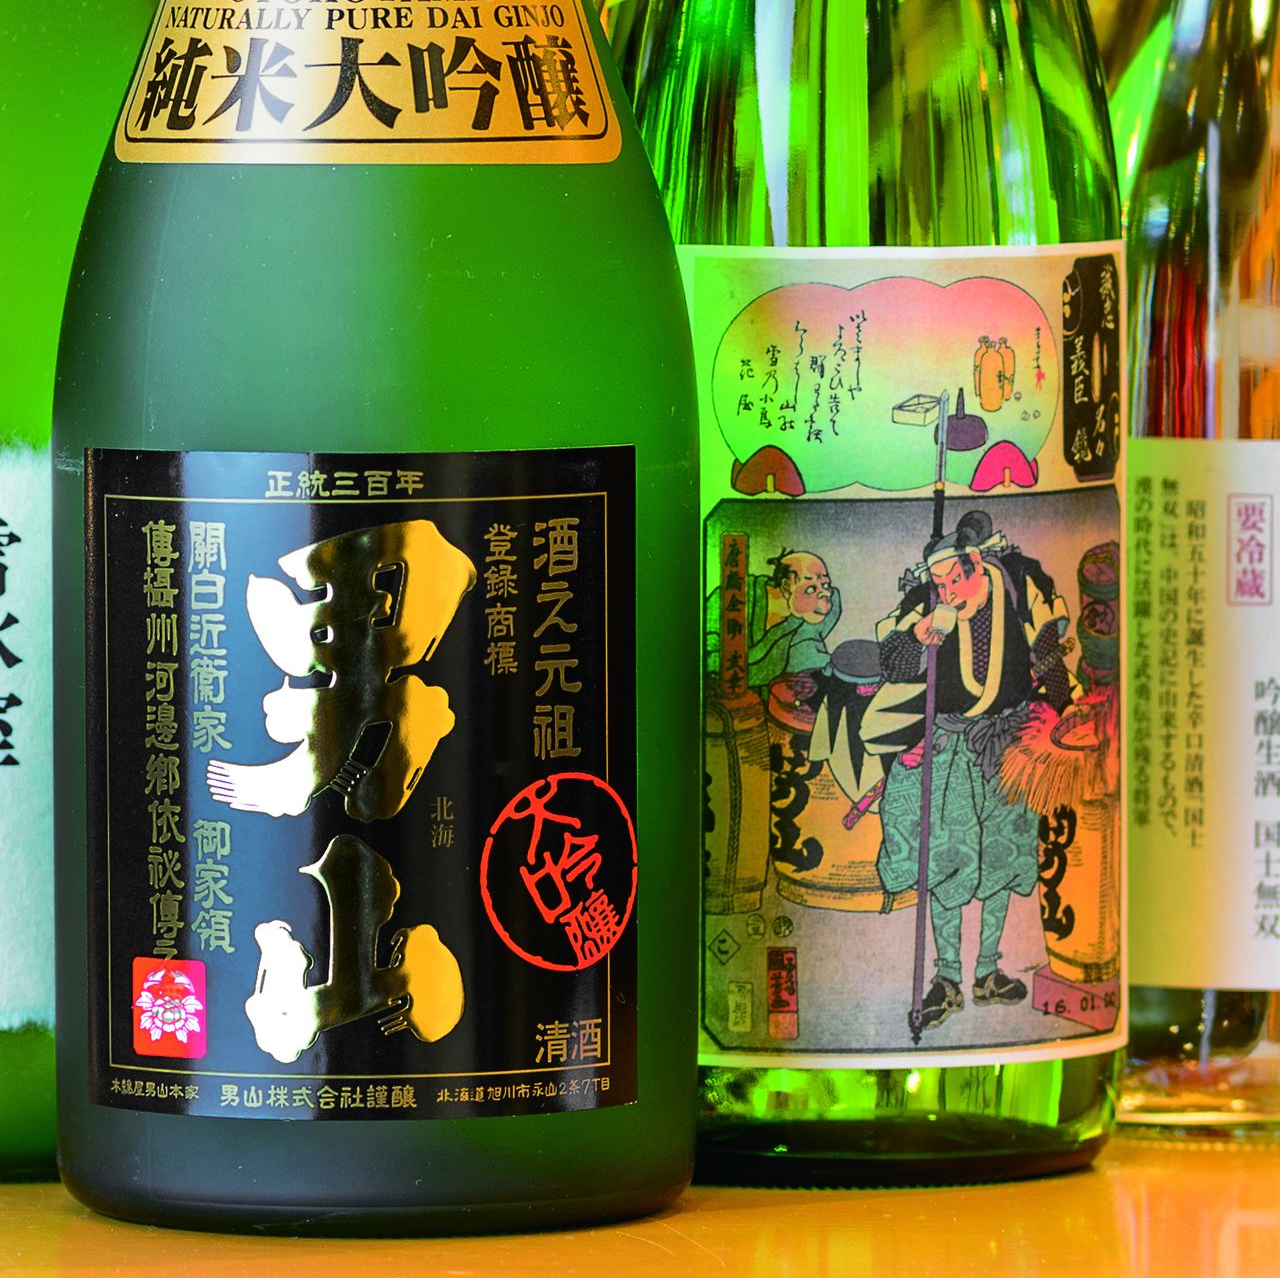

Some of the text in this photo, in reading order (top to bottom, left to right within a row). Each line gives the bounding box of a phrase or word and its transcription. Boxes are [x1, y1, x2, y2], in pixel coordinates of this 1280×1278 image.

[165, 4, 565, 30] NATURALLY PURE DAI GINJO
[134, 34, 590, 133] 純米大吟醸
[265, 469, 424, 498] 正統三百年
[1235, 501, 1266, 599] 要冷蔵
[533, 517, 581, 760] 酒之元祖
[207, 519, 476, 1064] 男山
[191, 819, 235, 953] 御家領
[534, 1019, 602, 1064] 清酒
